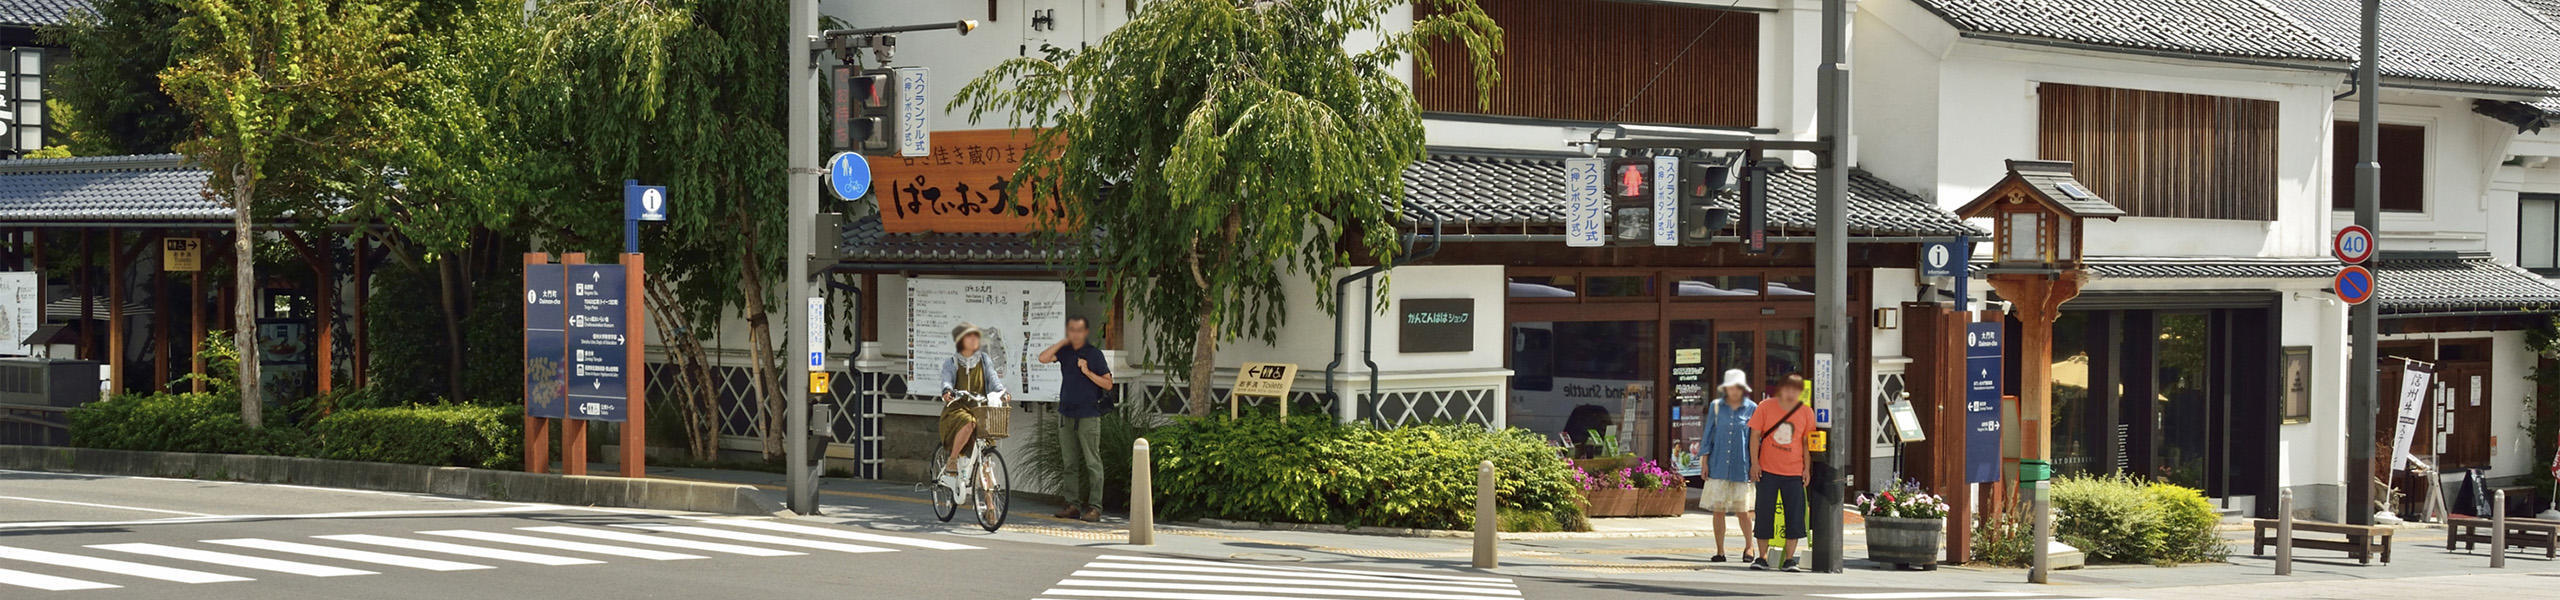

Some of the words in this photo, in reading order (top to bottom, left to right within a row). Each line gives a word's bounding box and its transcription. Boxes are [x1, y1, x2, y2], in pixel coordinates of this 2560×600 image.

[914, 72, 925, 151] スクランブル式
[1585, 163, 1599, 241] スクランブル式
[1667, 162, 1675, 240] スクランブル式
[2343, 236, 2364, 253] 40
[1262, 381, 1284, 390] Toilets
